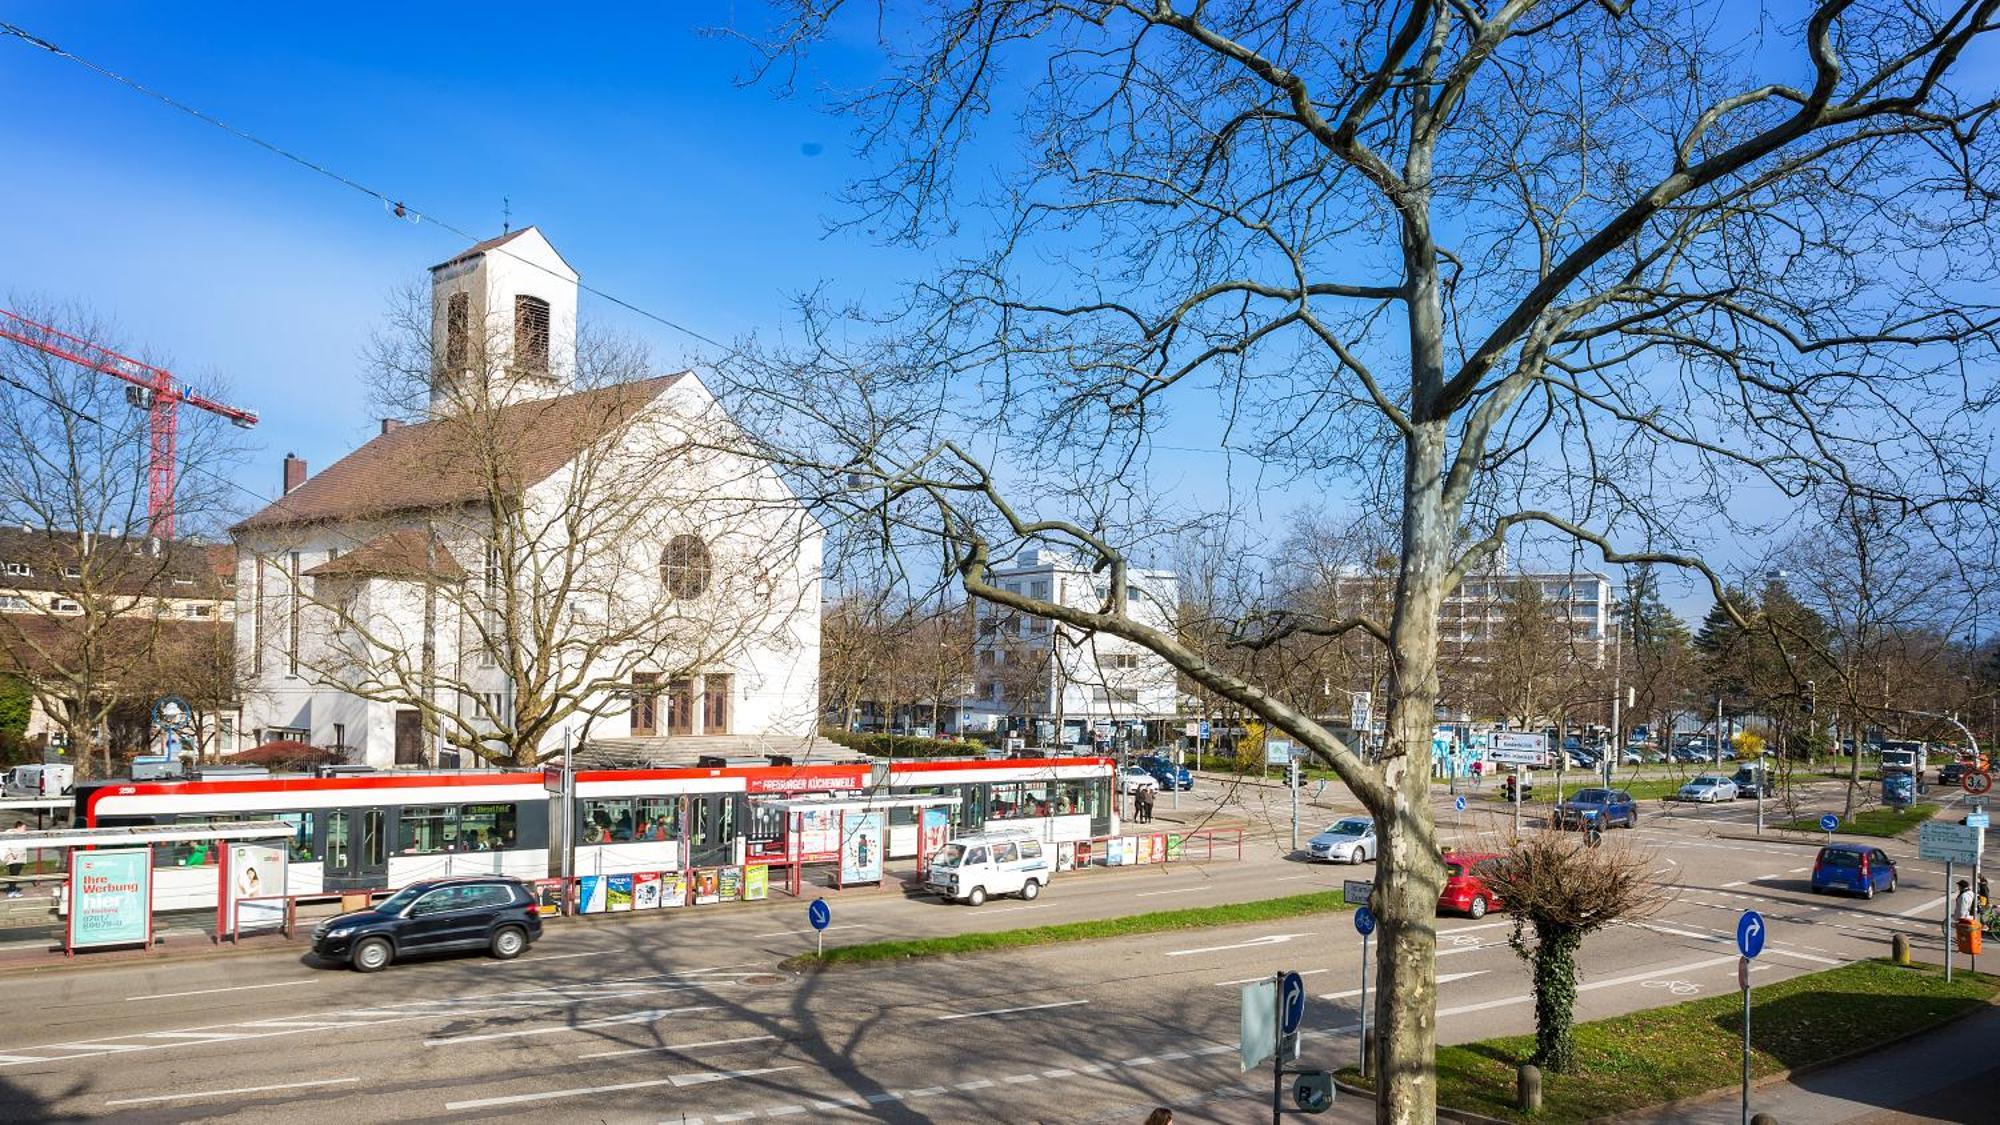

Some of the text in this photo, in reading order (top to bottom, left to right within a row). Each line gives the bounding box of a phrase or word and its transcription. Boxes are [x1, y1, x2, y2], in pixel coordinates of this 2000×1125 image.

[83, 876, 108, 884] Ihre
[83, 883, 138, 894] Werbung
[83, 894, 122, 909] hier
